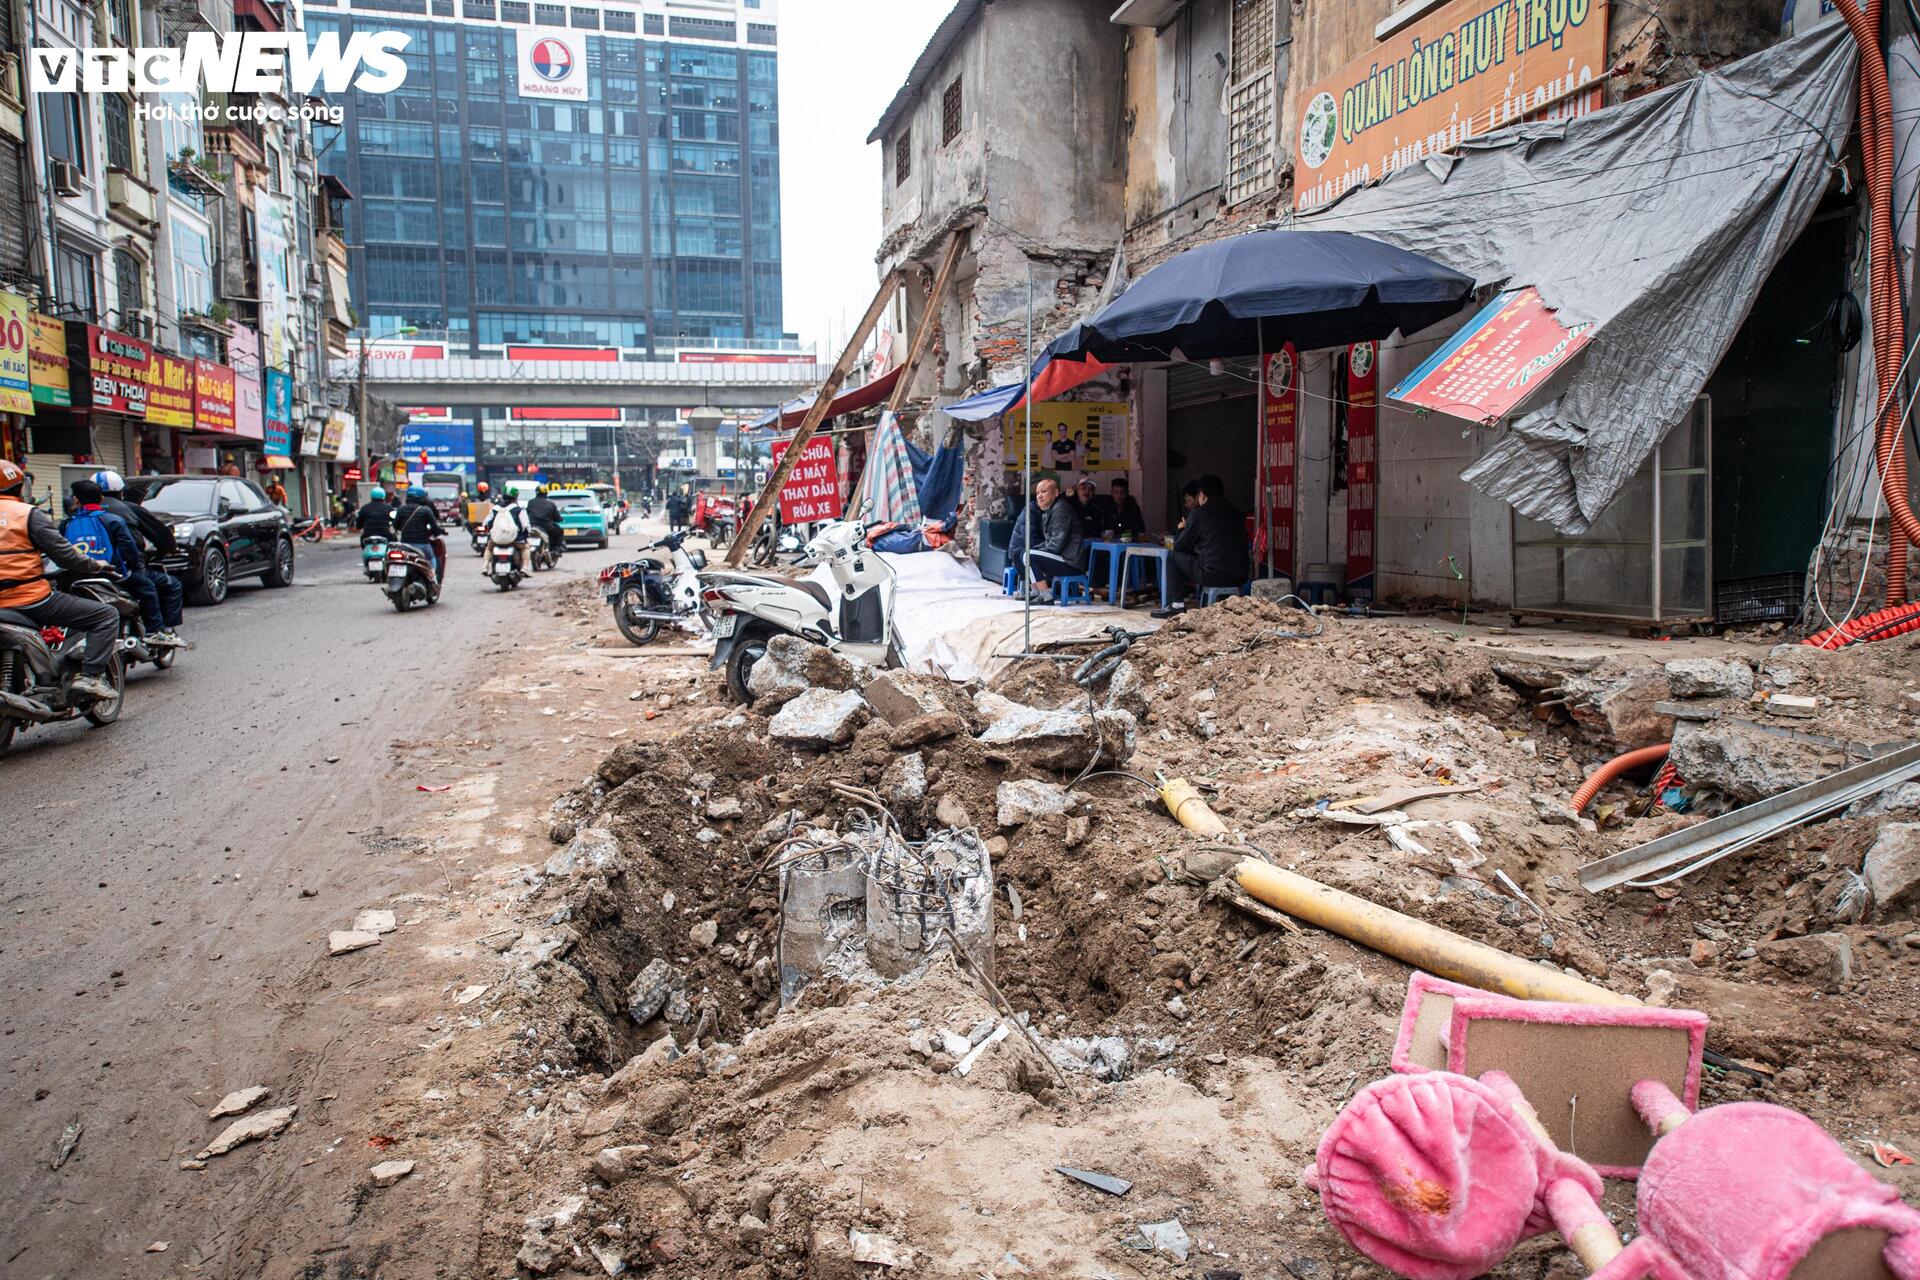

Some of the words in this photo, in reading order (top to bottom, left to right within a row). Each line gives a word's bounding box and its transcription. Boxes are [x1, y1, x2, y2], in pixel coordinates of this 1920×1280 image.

[1342, 63, 1394, 144] QUÁN
[1397, 37, 1455, 114] LÒNG
[1459, 0, 1511, 83] HUY
[524, 84, 559, 94] HOANG
[562, 87, 582, 95] HUY
[94, 375, 117, 396] ĐIỆN
[119, 383, 147, 402] THOẠI
[1267, 405, 1278, 415] UÁN
[801, 445, 831, 461] CHỮA
[671, 459, 693, 467] ACB
[789, 469, 802, 482] XE
[804, 463, 828, 479] MÁY
[782, 484, 809, 501] THAY
[792, 501, 815, 518] RỬA
[817, 502, 831, 514] XE
